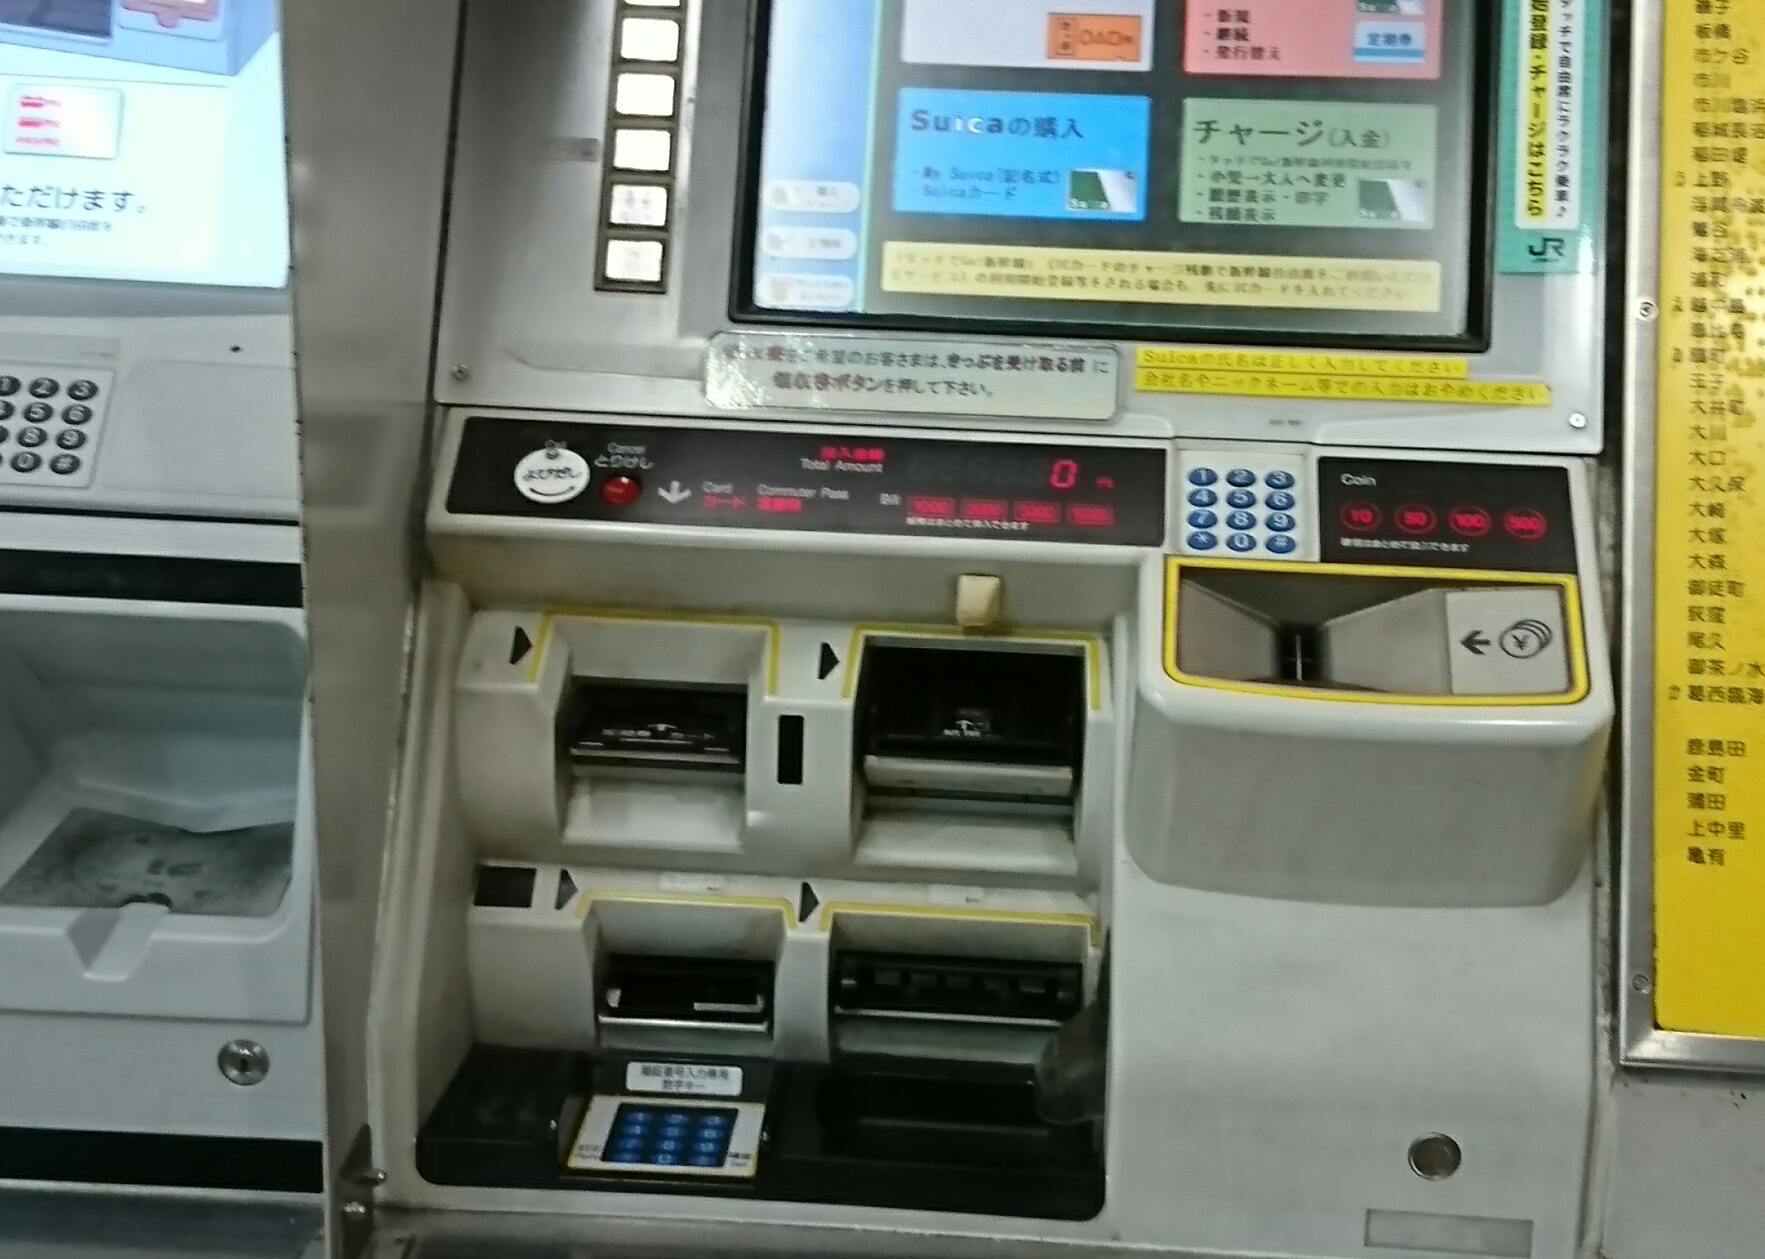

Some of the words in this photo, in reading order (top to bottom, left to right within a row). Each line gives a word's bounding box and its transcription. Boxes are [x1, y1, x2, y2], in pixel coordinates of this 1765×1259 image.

[911, 108, 1084, 139] Suicaの購入
[1688, 449, 1726, 466] 大口
[1050, 460, 1079, 489] 0
[1341, 473, 1377, 487] Coin
[1687, 738, 1746, 758] 鹿島田
[1687, 764, 1726, 784] 金町
[1687, 818, 1746, 841] 上中里
